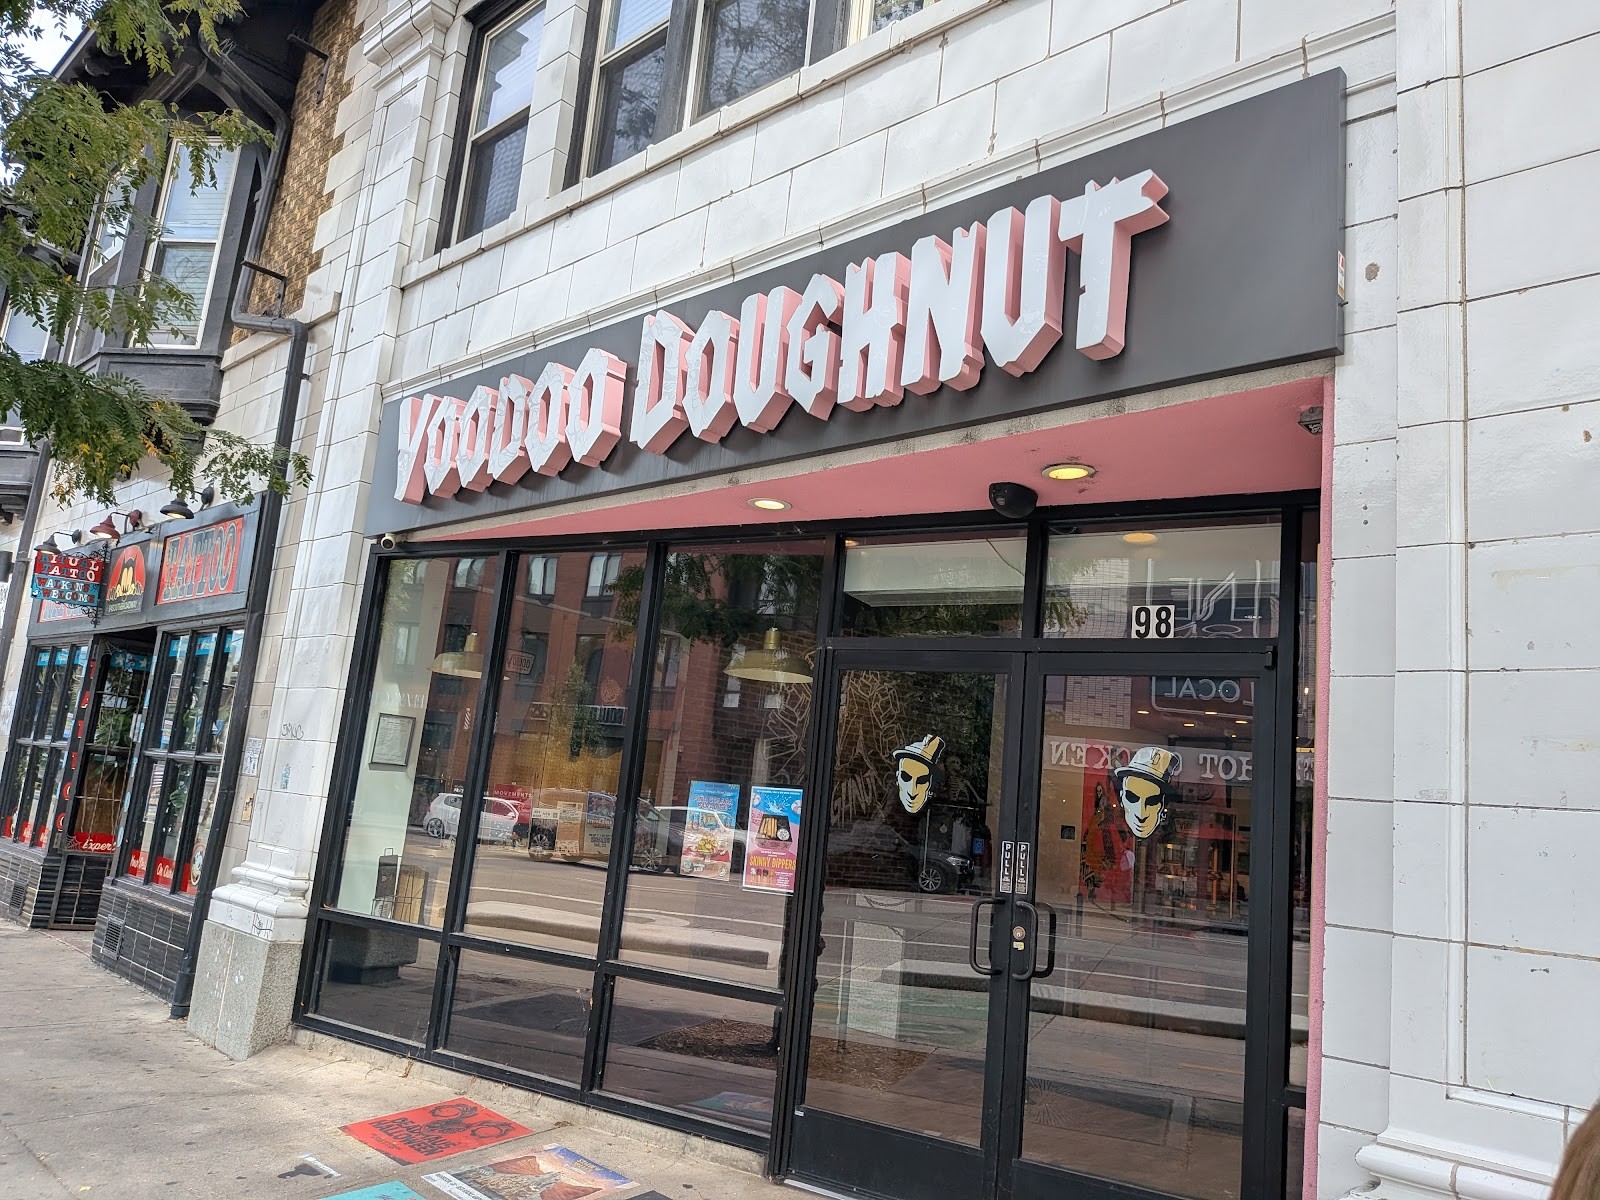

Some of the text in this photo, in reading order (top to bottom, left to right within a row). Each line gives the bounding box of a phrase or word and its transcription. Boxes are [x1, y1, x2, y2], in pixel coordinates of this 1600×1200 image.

[394, 169, 1169, 506] VOODOO DOUGHNUT
[40, 553, 99, 572] RITUAL
[42, 563, 96, 581] TATTOO
[162, 522, 237, 601] TATTOO
[41, 588, 95, 603] WELCOME
[1135, 607, 1172, 638] 98
[495, 790, 532, 798] MOVEMENTS
[749, 855, 796, 871] SKINNY DIPPERS
[1004, 843, 1012, 875] PULL
[368, 1119, 444, 1156] HALLOWEEN
